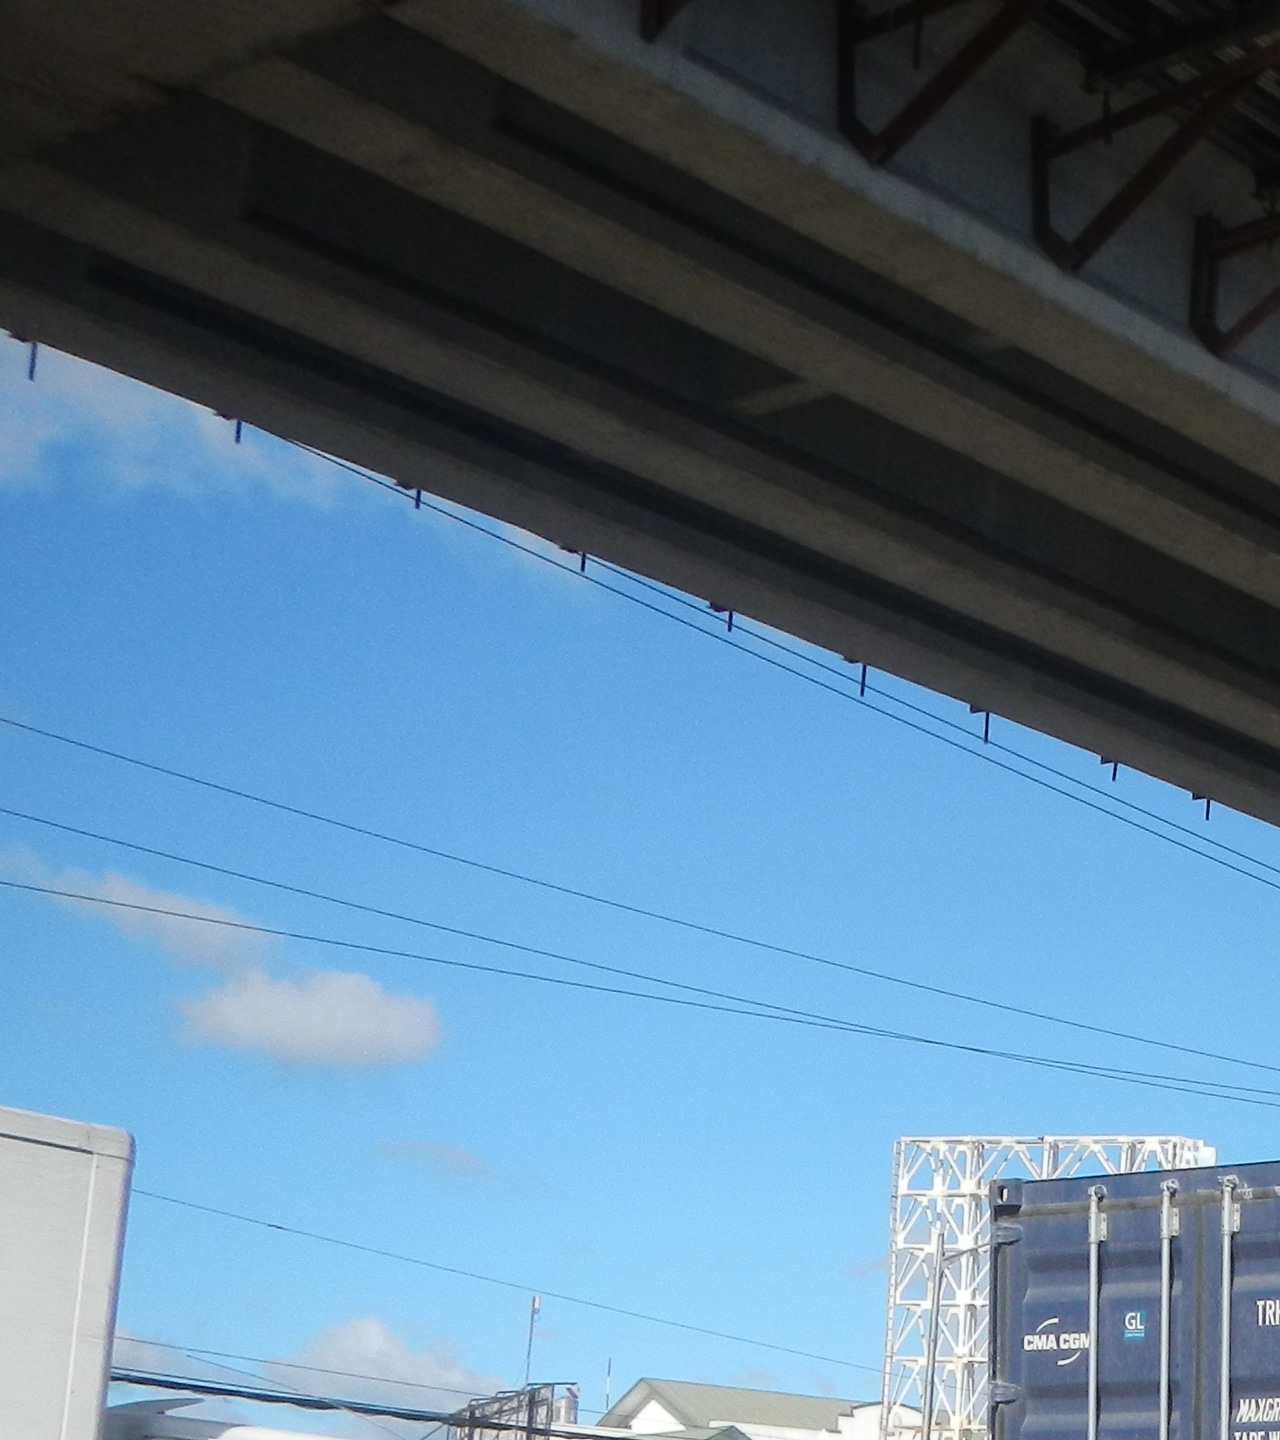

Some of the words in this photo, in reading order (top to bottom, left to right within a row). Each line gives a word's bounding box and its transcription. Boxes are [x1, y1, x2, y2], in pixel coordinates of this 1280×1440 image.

[1125, 1312, 1144, 1329] GL
[1023, 1334, 1057, 1351] CMA
[1060, 1333, 1090, 1349] CGM
